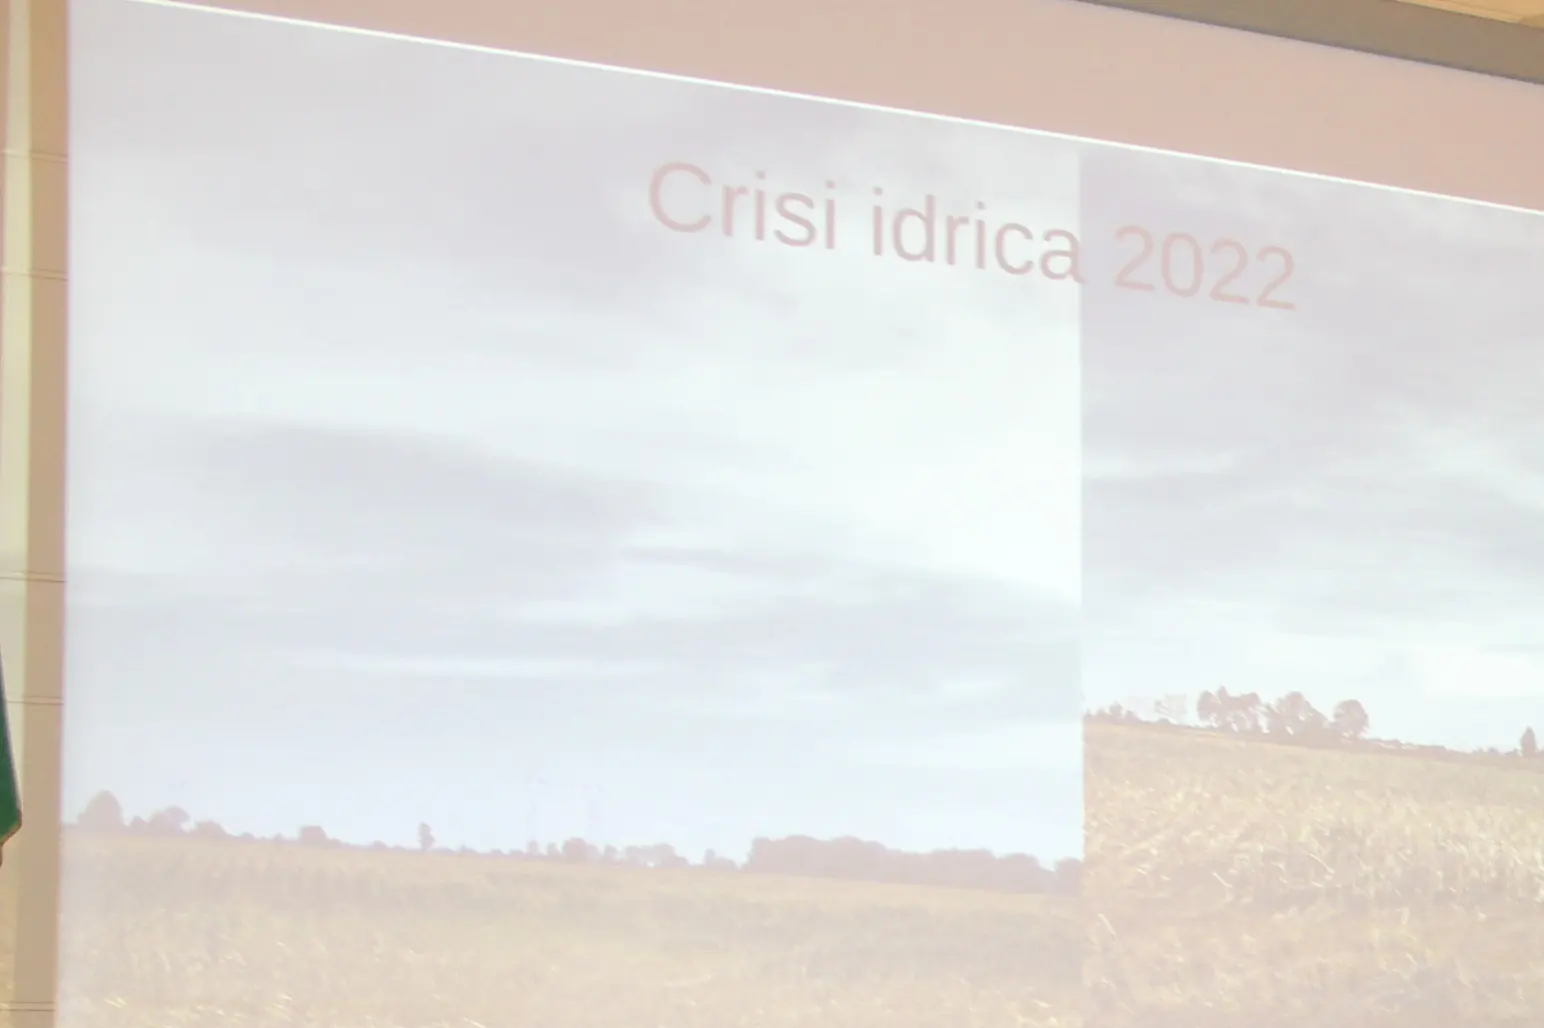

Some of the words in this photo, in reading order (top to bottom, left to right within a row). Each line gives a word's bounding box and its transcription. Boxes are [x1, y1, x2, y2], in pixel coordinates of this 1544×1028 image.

[647, 160, 838, 250] Crisi
[871, 185, 1086, 285] idrica
[1111, 223, 1299, 312] 2022
